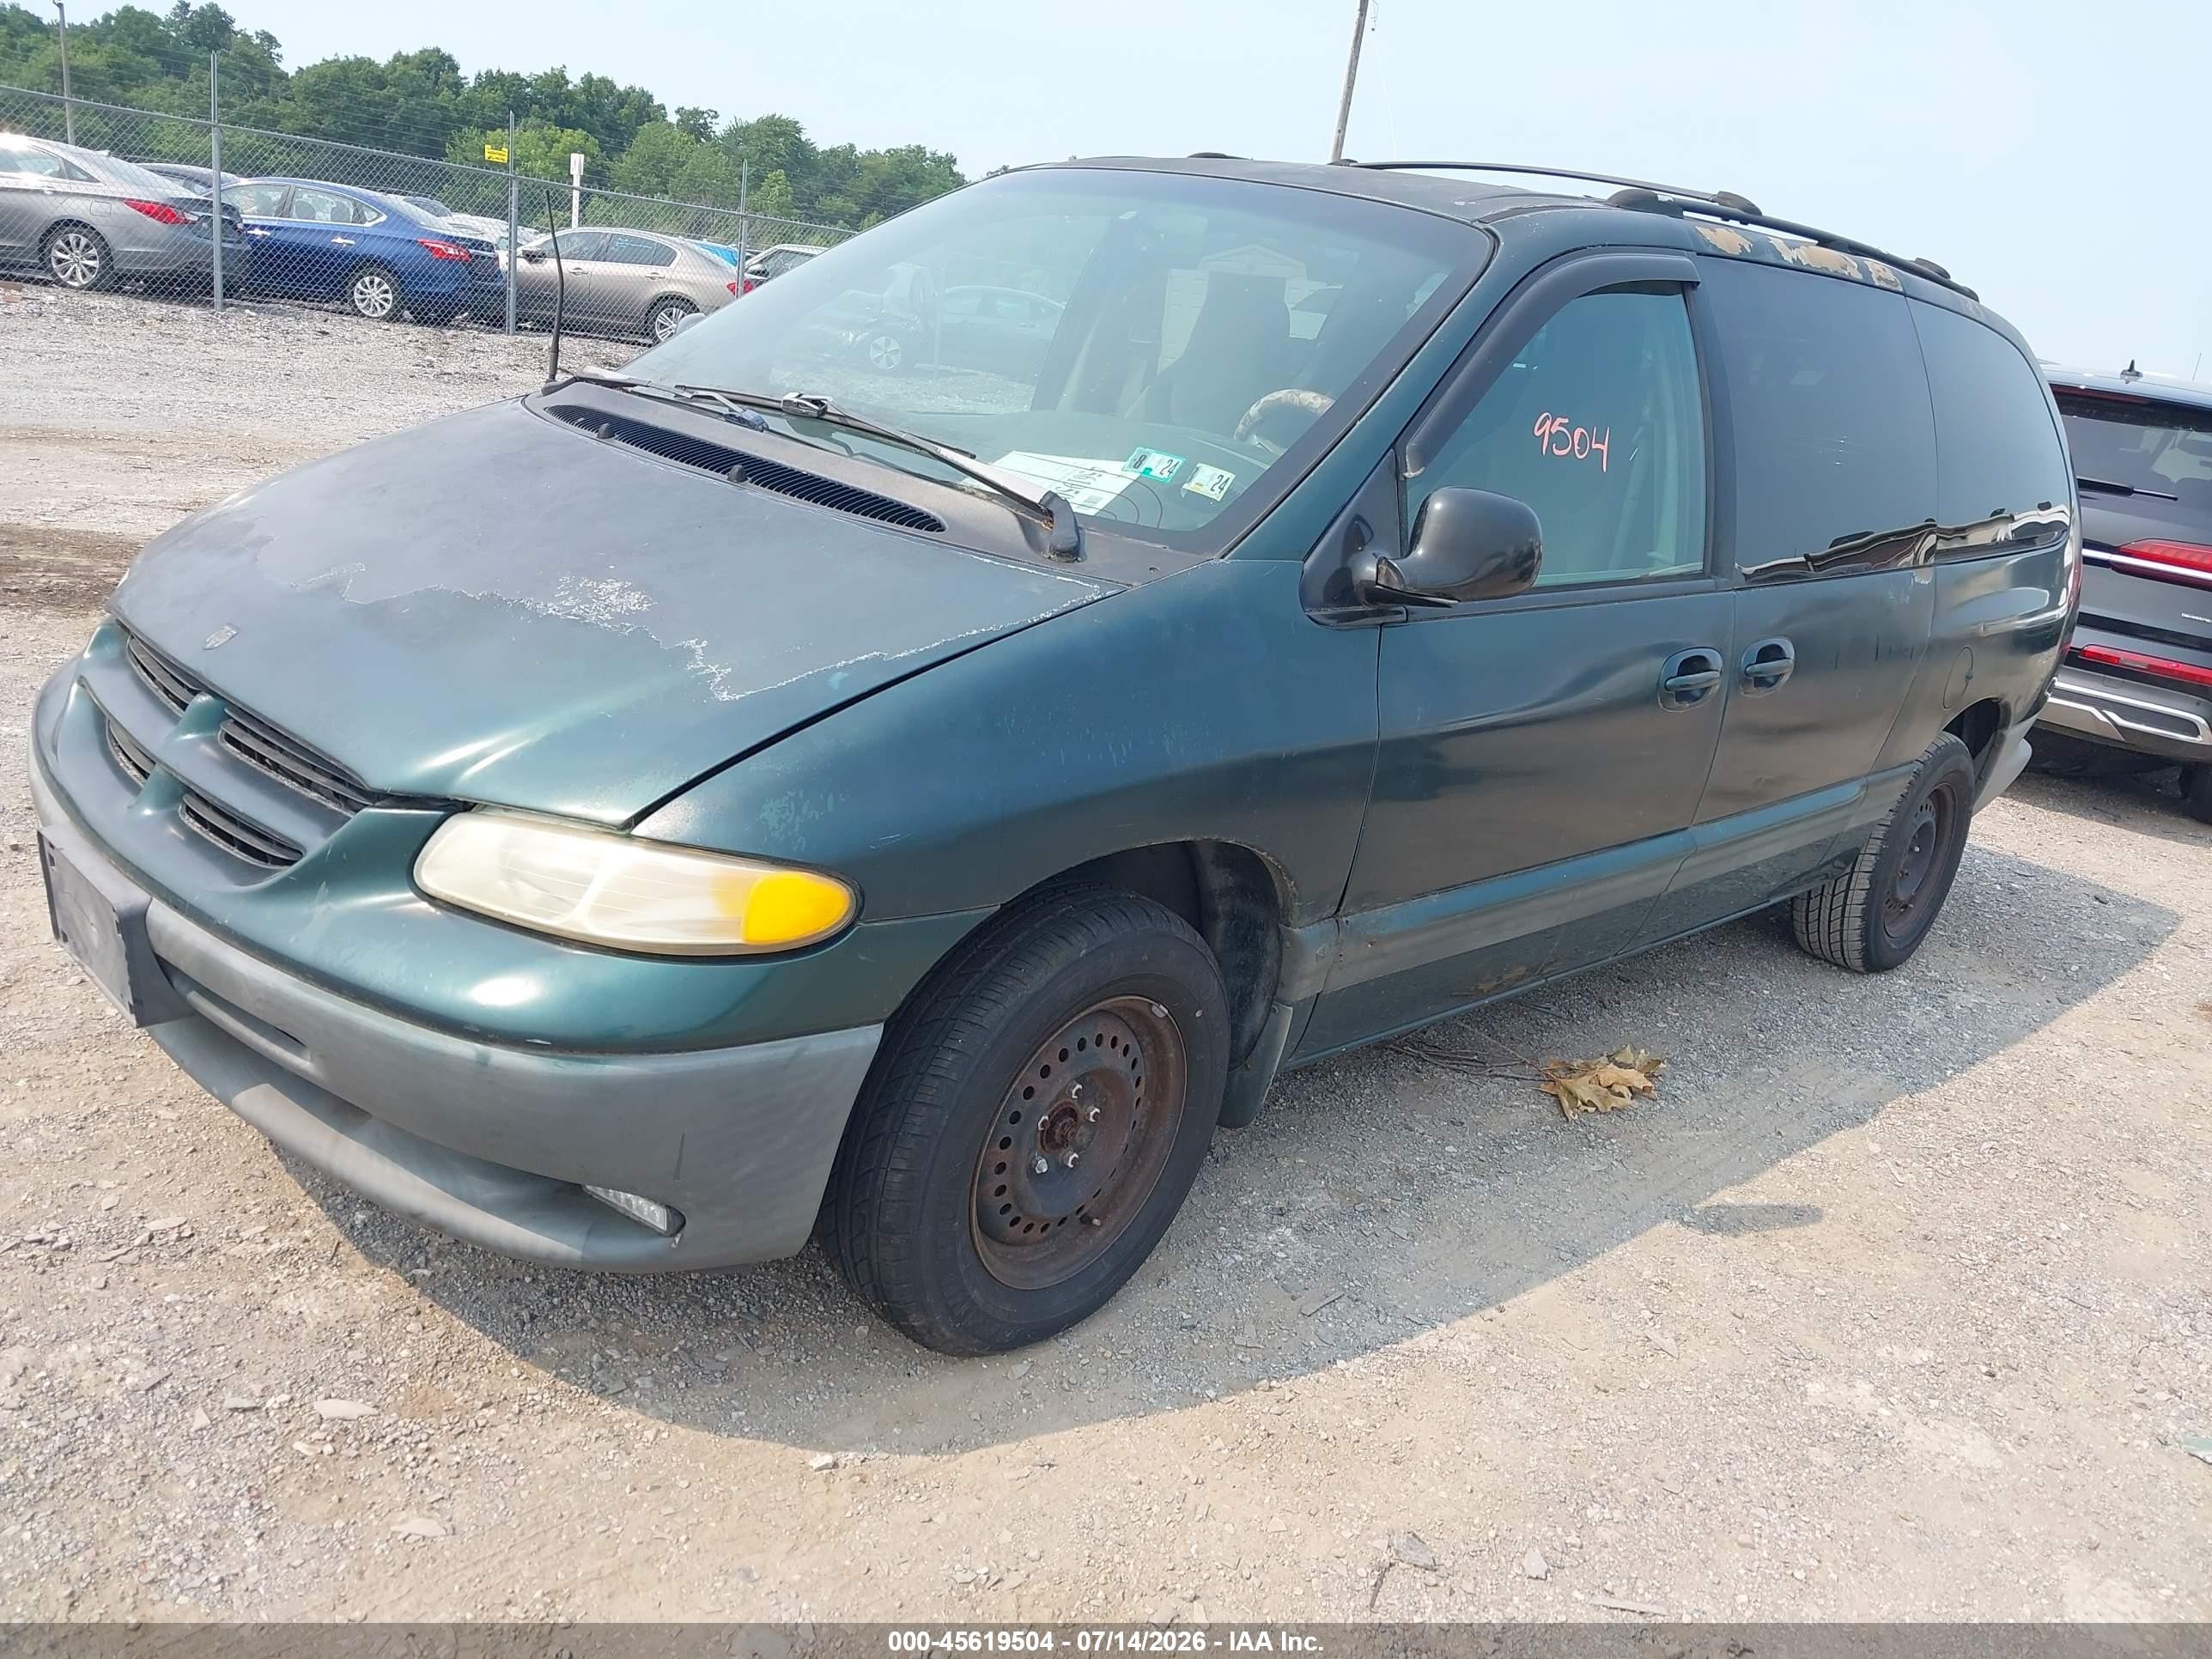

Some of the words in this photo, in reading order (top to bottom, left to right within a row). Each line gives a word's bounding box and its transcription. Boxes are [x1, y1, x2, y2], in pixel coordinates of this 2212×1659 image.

[1534, 412, 1610, 473] 9504
[1159, 459, 1179, 478] 24
[1211, 474, 1231, 495] 24
